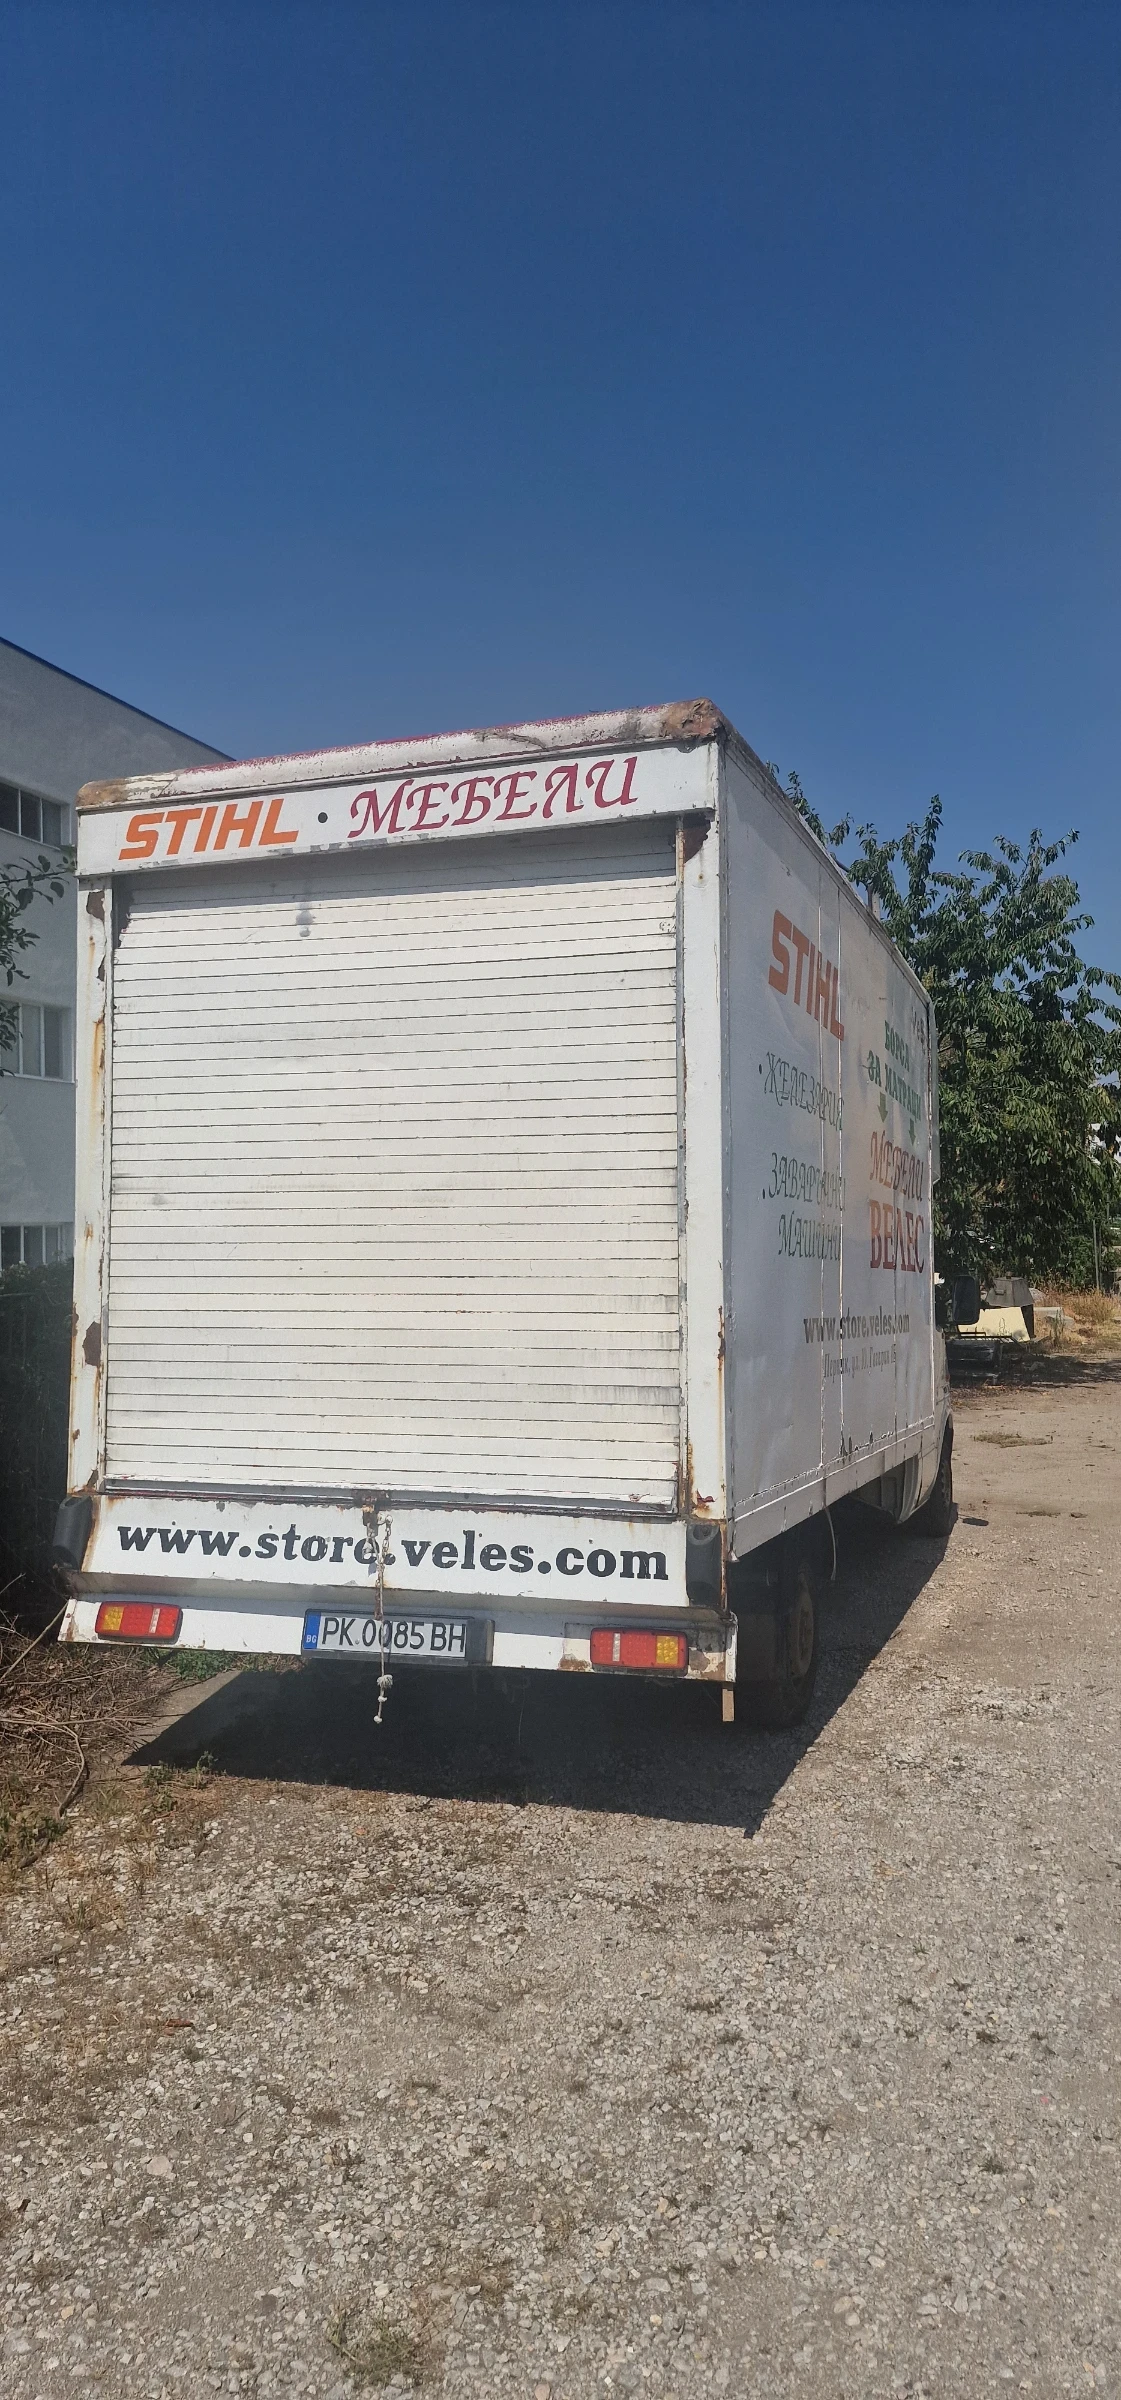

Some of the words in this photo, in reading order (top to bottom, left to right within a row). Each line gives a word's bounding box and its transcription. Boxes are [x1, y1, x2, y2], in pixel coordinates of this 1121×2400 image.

[347, 755, 639, 839] МЕБЕЛИ
[117, 799, 299, 860] STIHL
[768, 909, 845, 1042] STIHL
[866, 1049, 882, 1088] ЗА
[884, 1019, 910, 1073] БОРСА
[869, 1129, 924, 1202] МЕБЕЛИ
[869, 1199, 925, 1274] ВЕЛЕС
[116, 1524, 669, 1580] www.store.veles.com
[306, 1634, 317, 1644] BG
[321, 1616, 356, 1647] PK
[361, 1618, 425, 1650] 0085
[429, 1621, 467, 1653] BH
